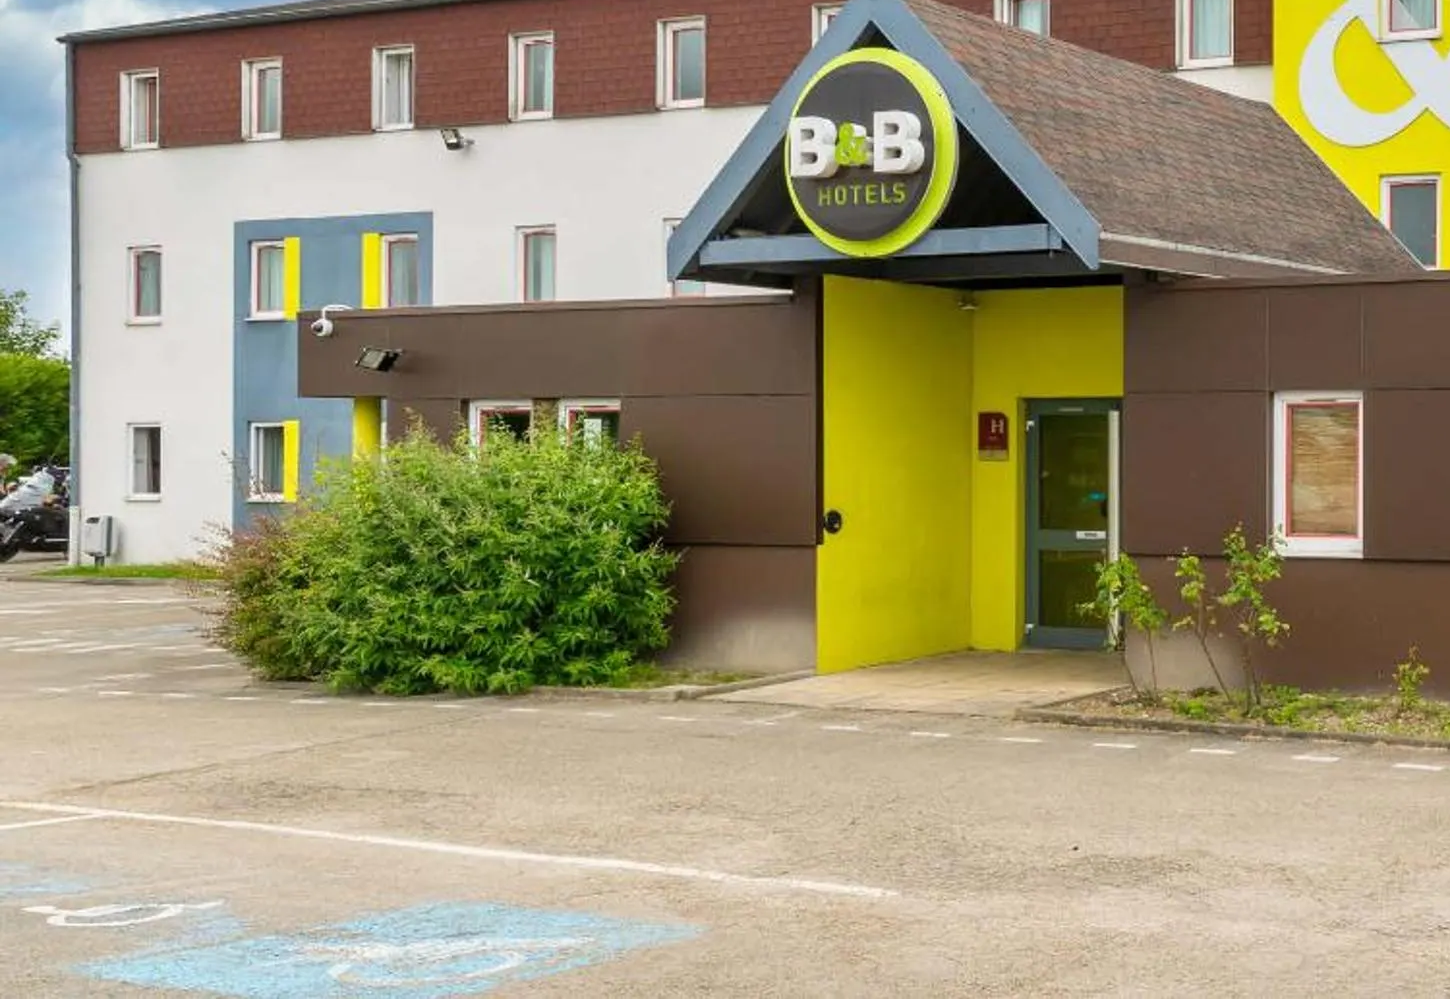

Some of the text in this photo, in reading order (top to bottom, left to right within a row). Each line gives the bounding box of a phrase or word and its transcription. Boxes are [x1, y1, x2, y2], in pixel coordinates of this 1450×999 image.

[789, 109, 926, 179] B&B
[818, 182, 907, 207] HOTELS
[991, 418, 1005, 434] H
